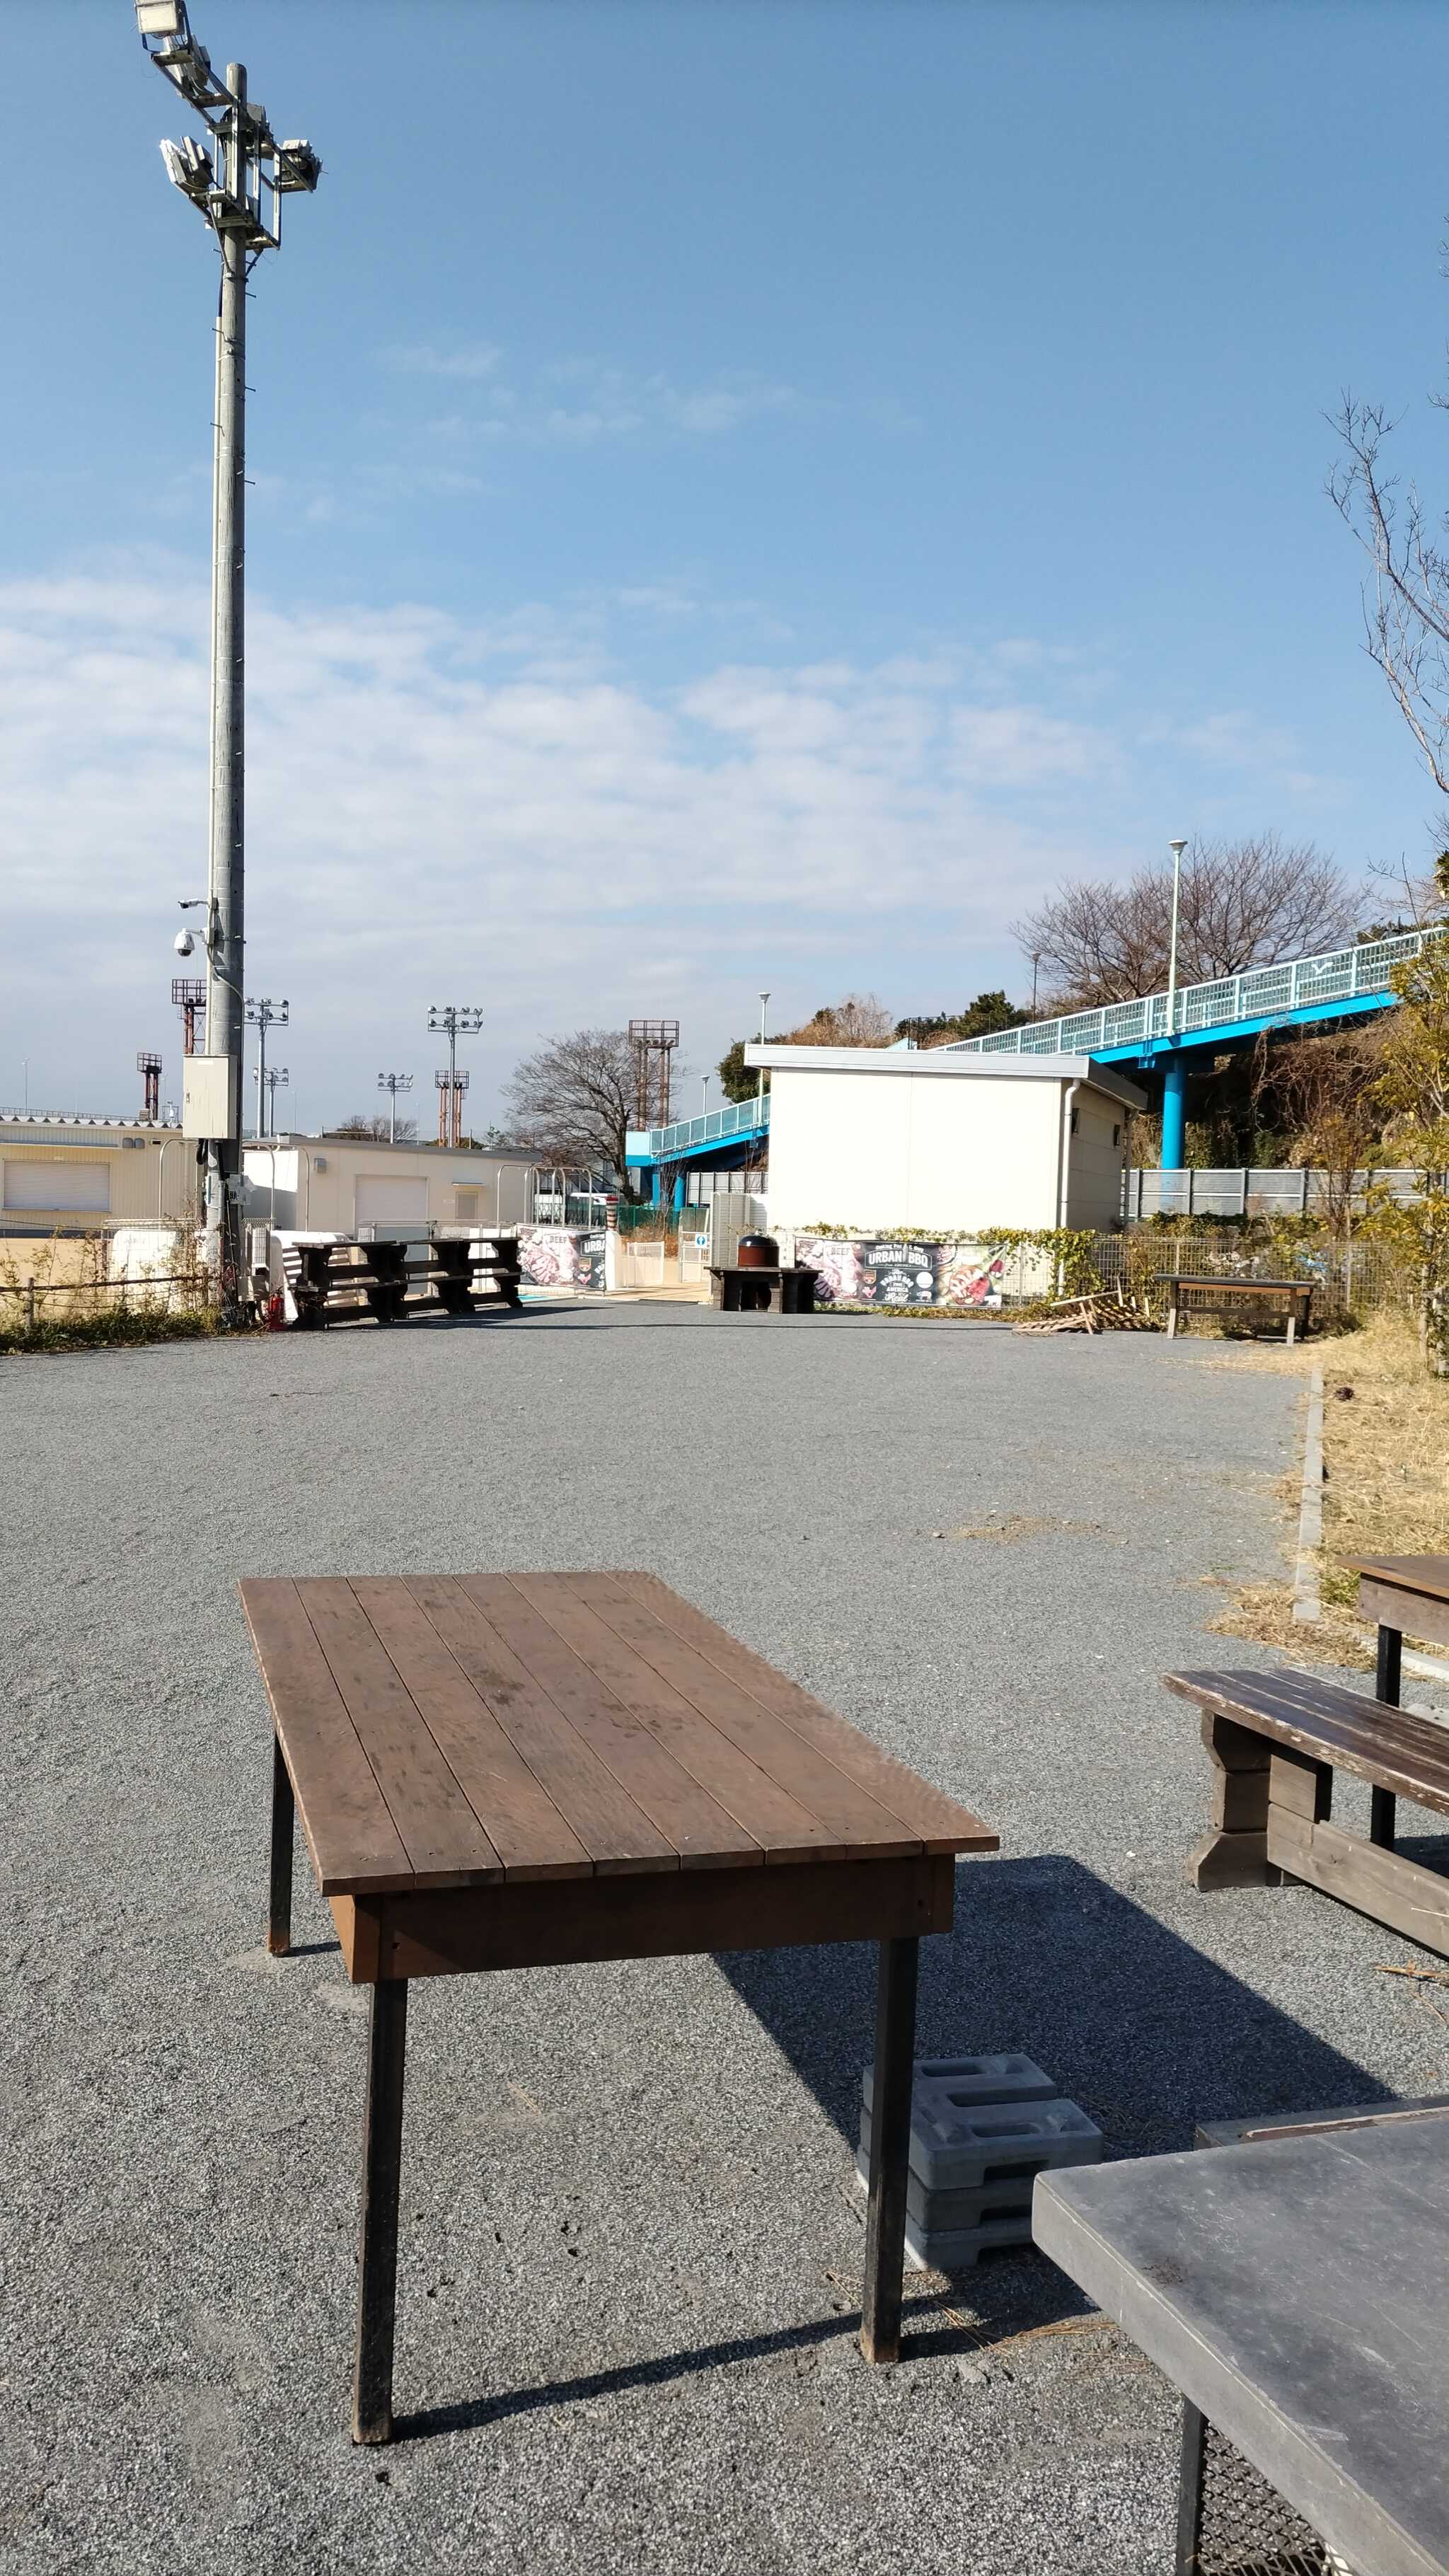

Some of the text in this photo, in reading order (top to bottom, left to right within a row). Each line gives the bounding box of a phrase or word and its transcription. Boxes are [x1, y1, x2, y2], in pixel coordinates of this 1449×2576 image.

[549, 1235, 567, 1244] BEEF
[831, 1247, 850, 1256] BEEF
[868, 1250, 928, 1268] URBAN BBQ
